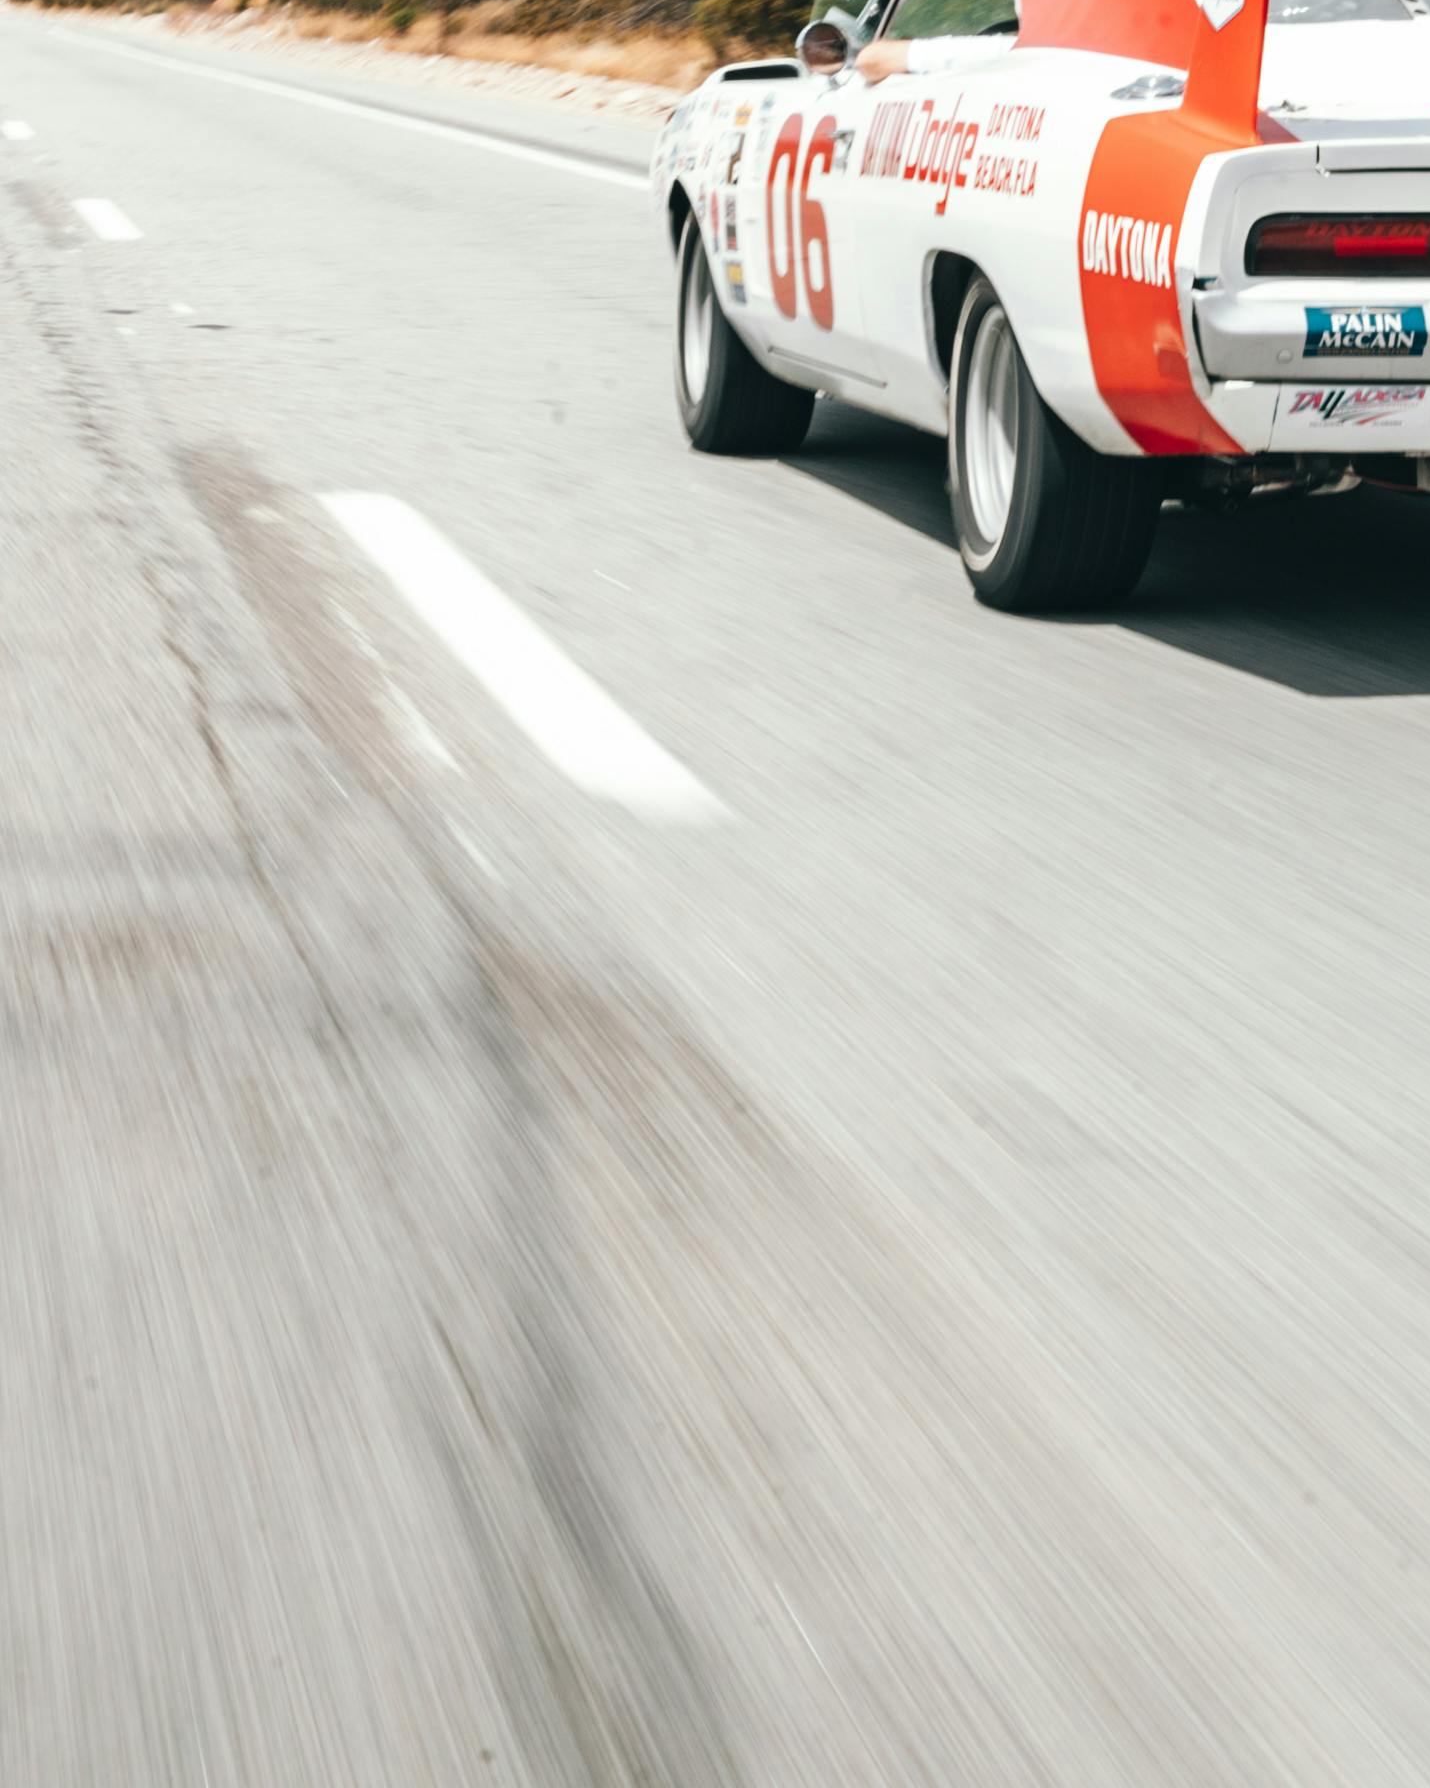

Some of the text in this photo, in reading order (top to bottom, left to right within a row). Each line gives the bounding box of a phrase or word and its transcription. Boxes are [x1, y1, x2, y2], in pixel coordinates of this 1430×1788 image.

[986, 104, 1046, 142] DAYTONA
[903, 92, 980, 216] Dodge
[766, 112, 837, 333] 06
[1083, 209, 1172, 290] DAYTONA
[1318, 331, 1415, 349] McCAIN
[1330, 313, 1403, 333] PALIN
